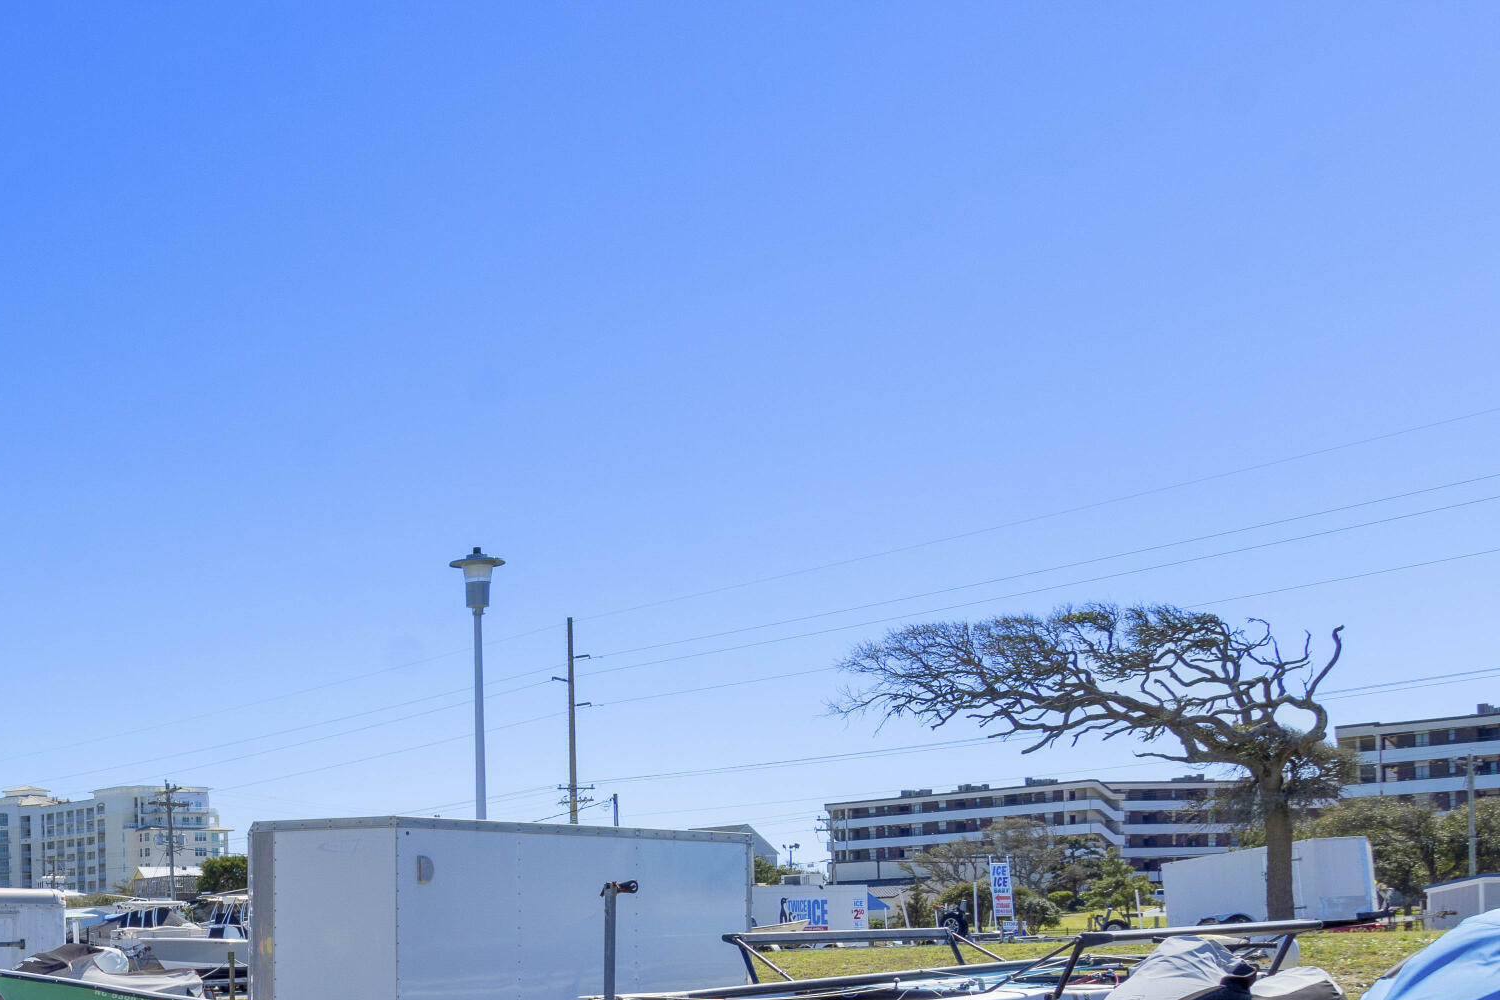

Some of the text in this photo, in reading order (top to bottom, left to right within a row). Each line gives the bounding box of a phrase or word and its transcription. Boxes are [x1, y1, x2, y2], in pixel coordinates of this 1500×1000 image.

[992, 865, 1008, 876] ICE
[993, 877, 1008, 887] ICE
[788, 899, 828, 925] TWICE ICE
